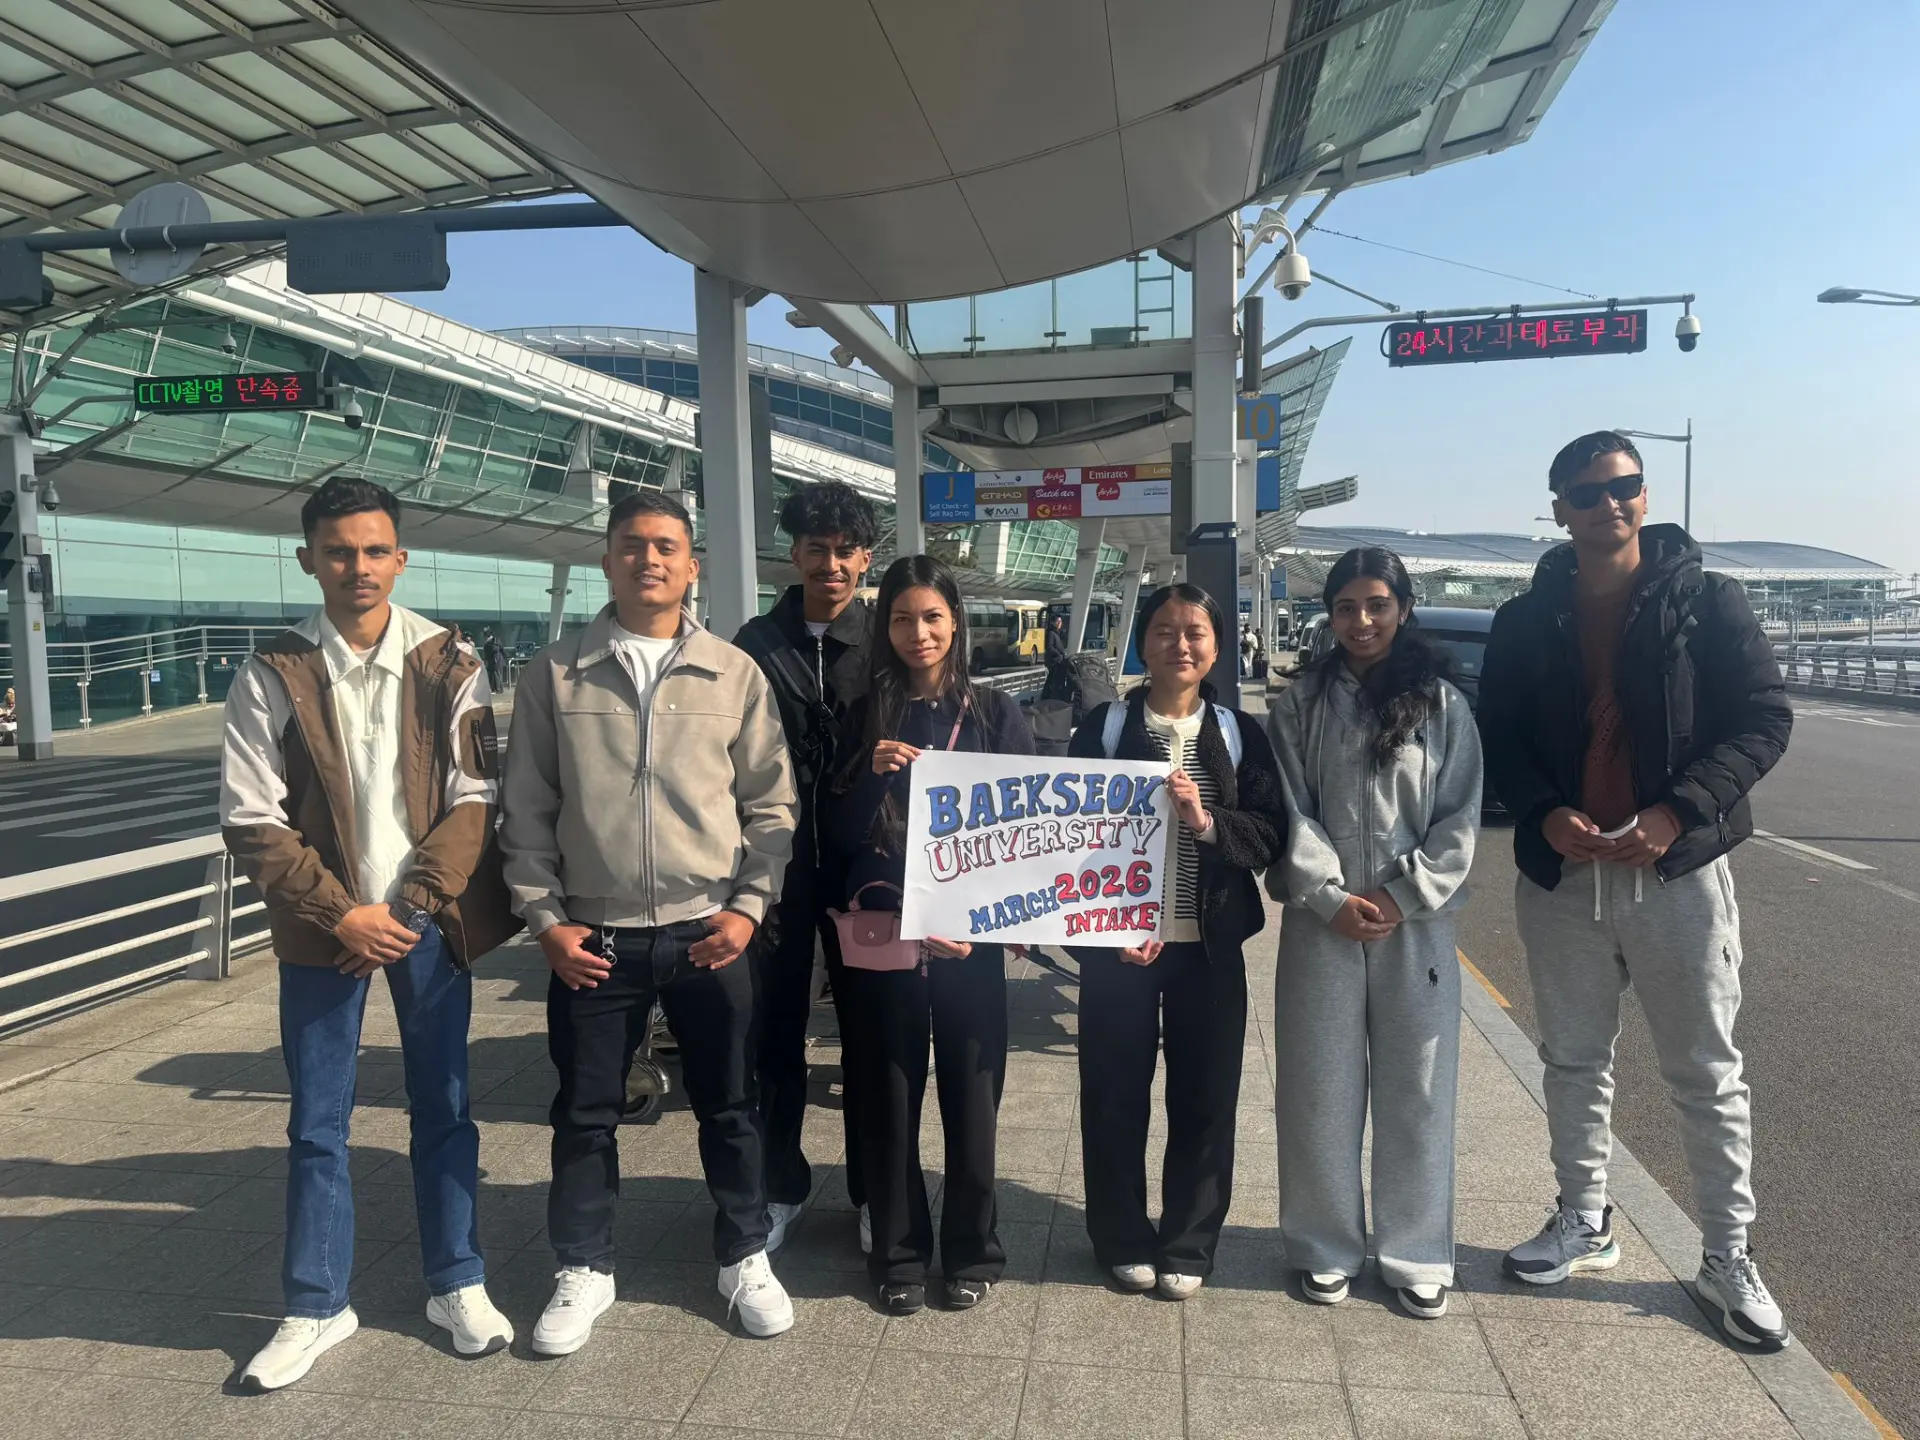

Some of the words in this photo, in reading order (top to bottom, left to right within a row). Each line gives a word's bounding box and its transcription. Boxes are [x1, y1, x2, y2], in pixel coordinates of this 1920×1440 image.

[138, 379, 223, 404] CCTV촬영
[236, 376, 302, 403] 단속중
[1089, 470, 1128, 480] Emirates
[944, 476, 955, 500] J
[980, 491, 1022, 500] ETIHAD
[1034, 488, 1060, 498] Batik
[929, 510, 941, 518] Self
[942, 510, 954, 518] Bag
[955, 510, 970, 518] Drop
[995, 507, 1019, 515] MAI
[925, 772, 1165, 839] BAEKSEOK
[924, 816, 1162, 883] UNIVERSITY
[968, 884, 1060, 935] MARCH
[1054, 860, 1153, 905] 2026
[1065, 901, 1160, 937] INTAKE
